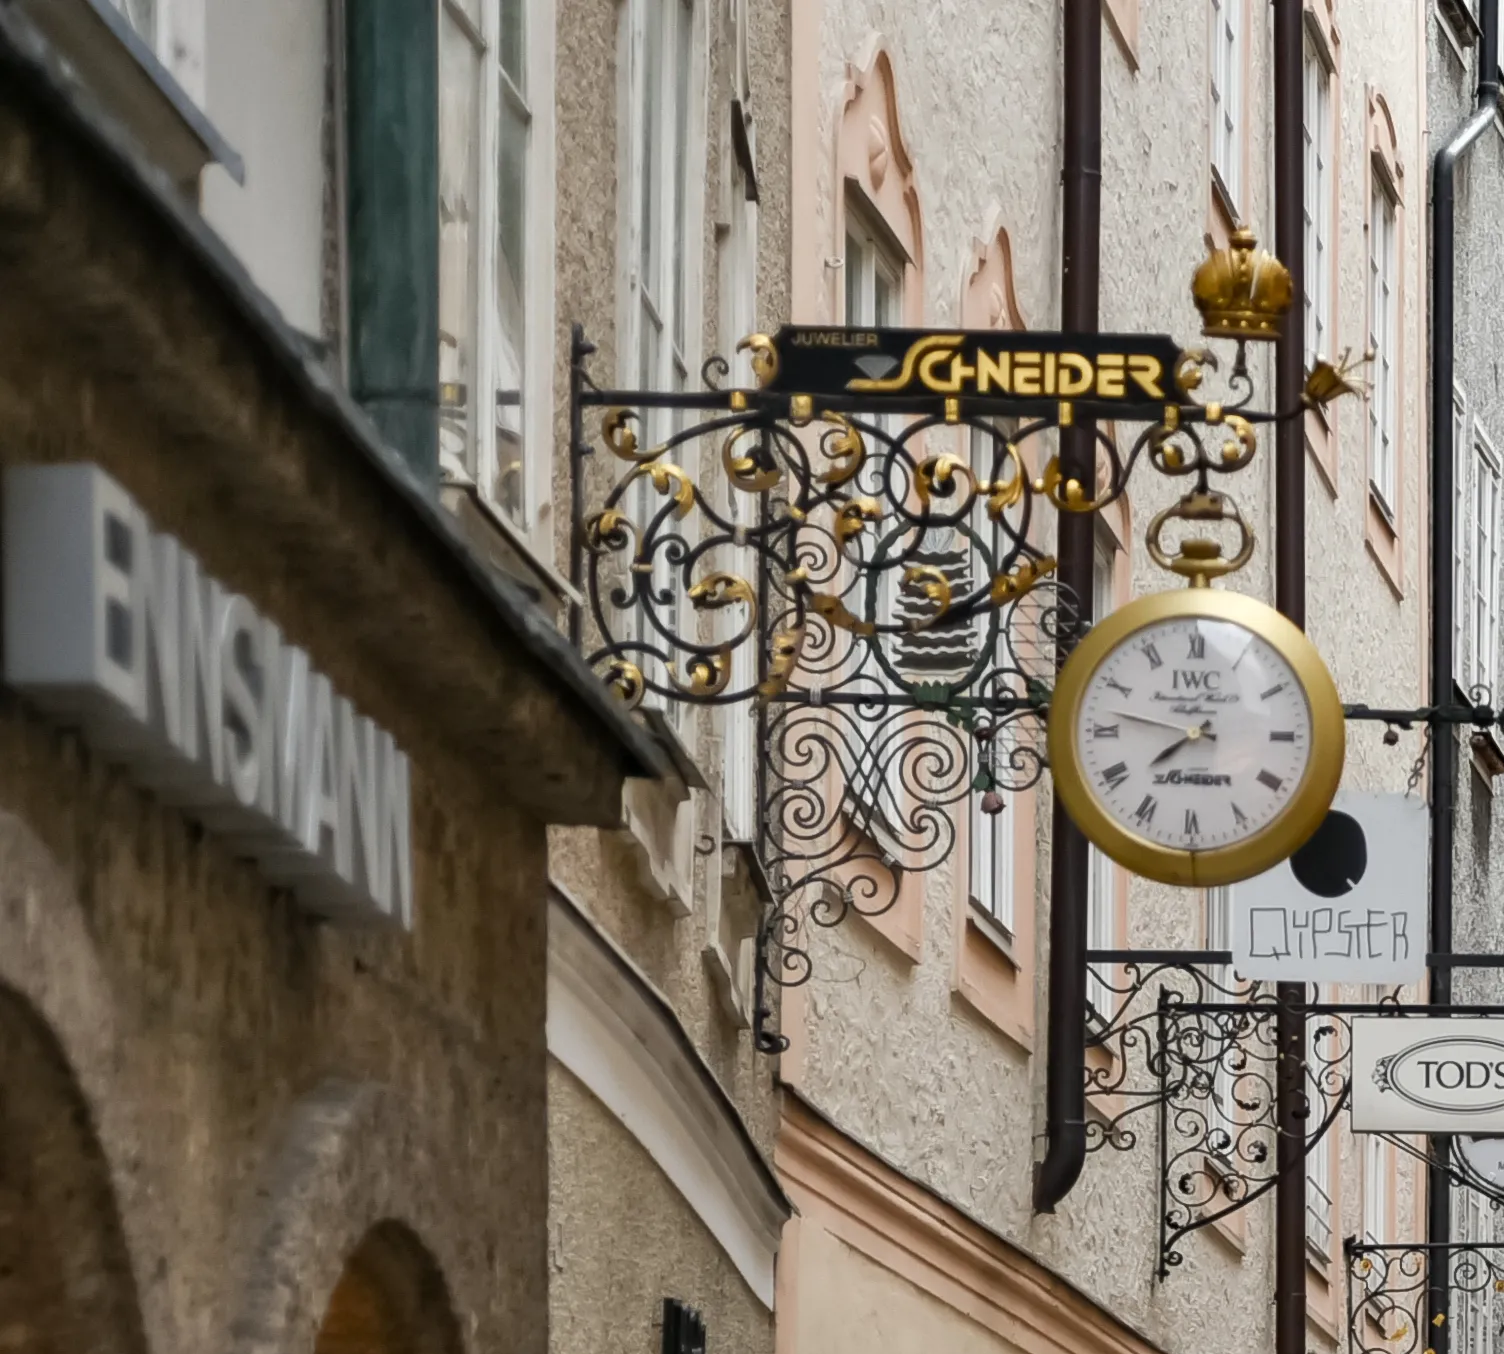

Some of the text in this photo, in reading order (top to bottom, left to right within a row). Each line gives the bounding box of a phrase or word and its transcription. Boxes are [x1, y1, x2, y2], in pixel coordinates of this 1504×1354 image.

[790, 331, 878, 347] JUWELIER
[846, 334, 1166, 398] SCHNEIDER
[1172, 670, 1221, 690] IWC
